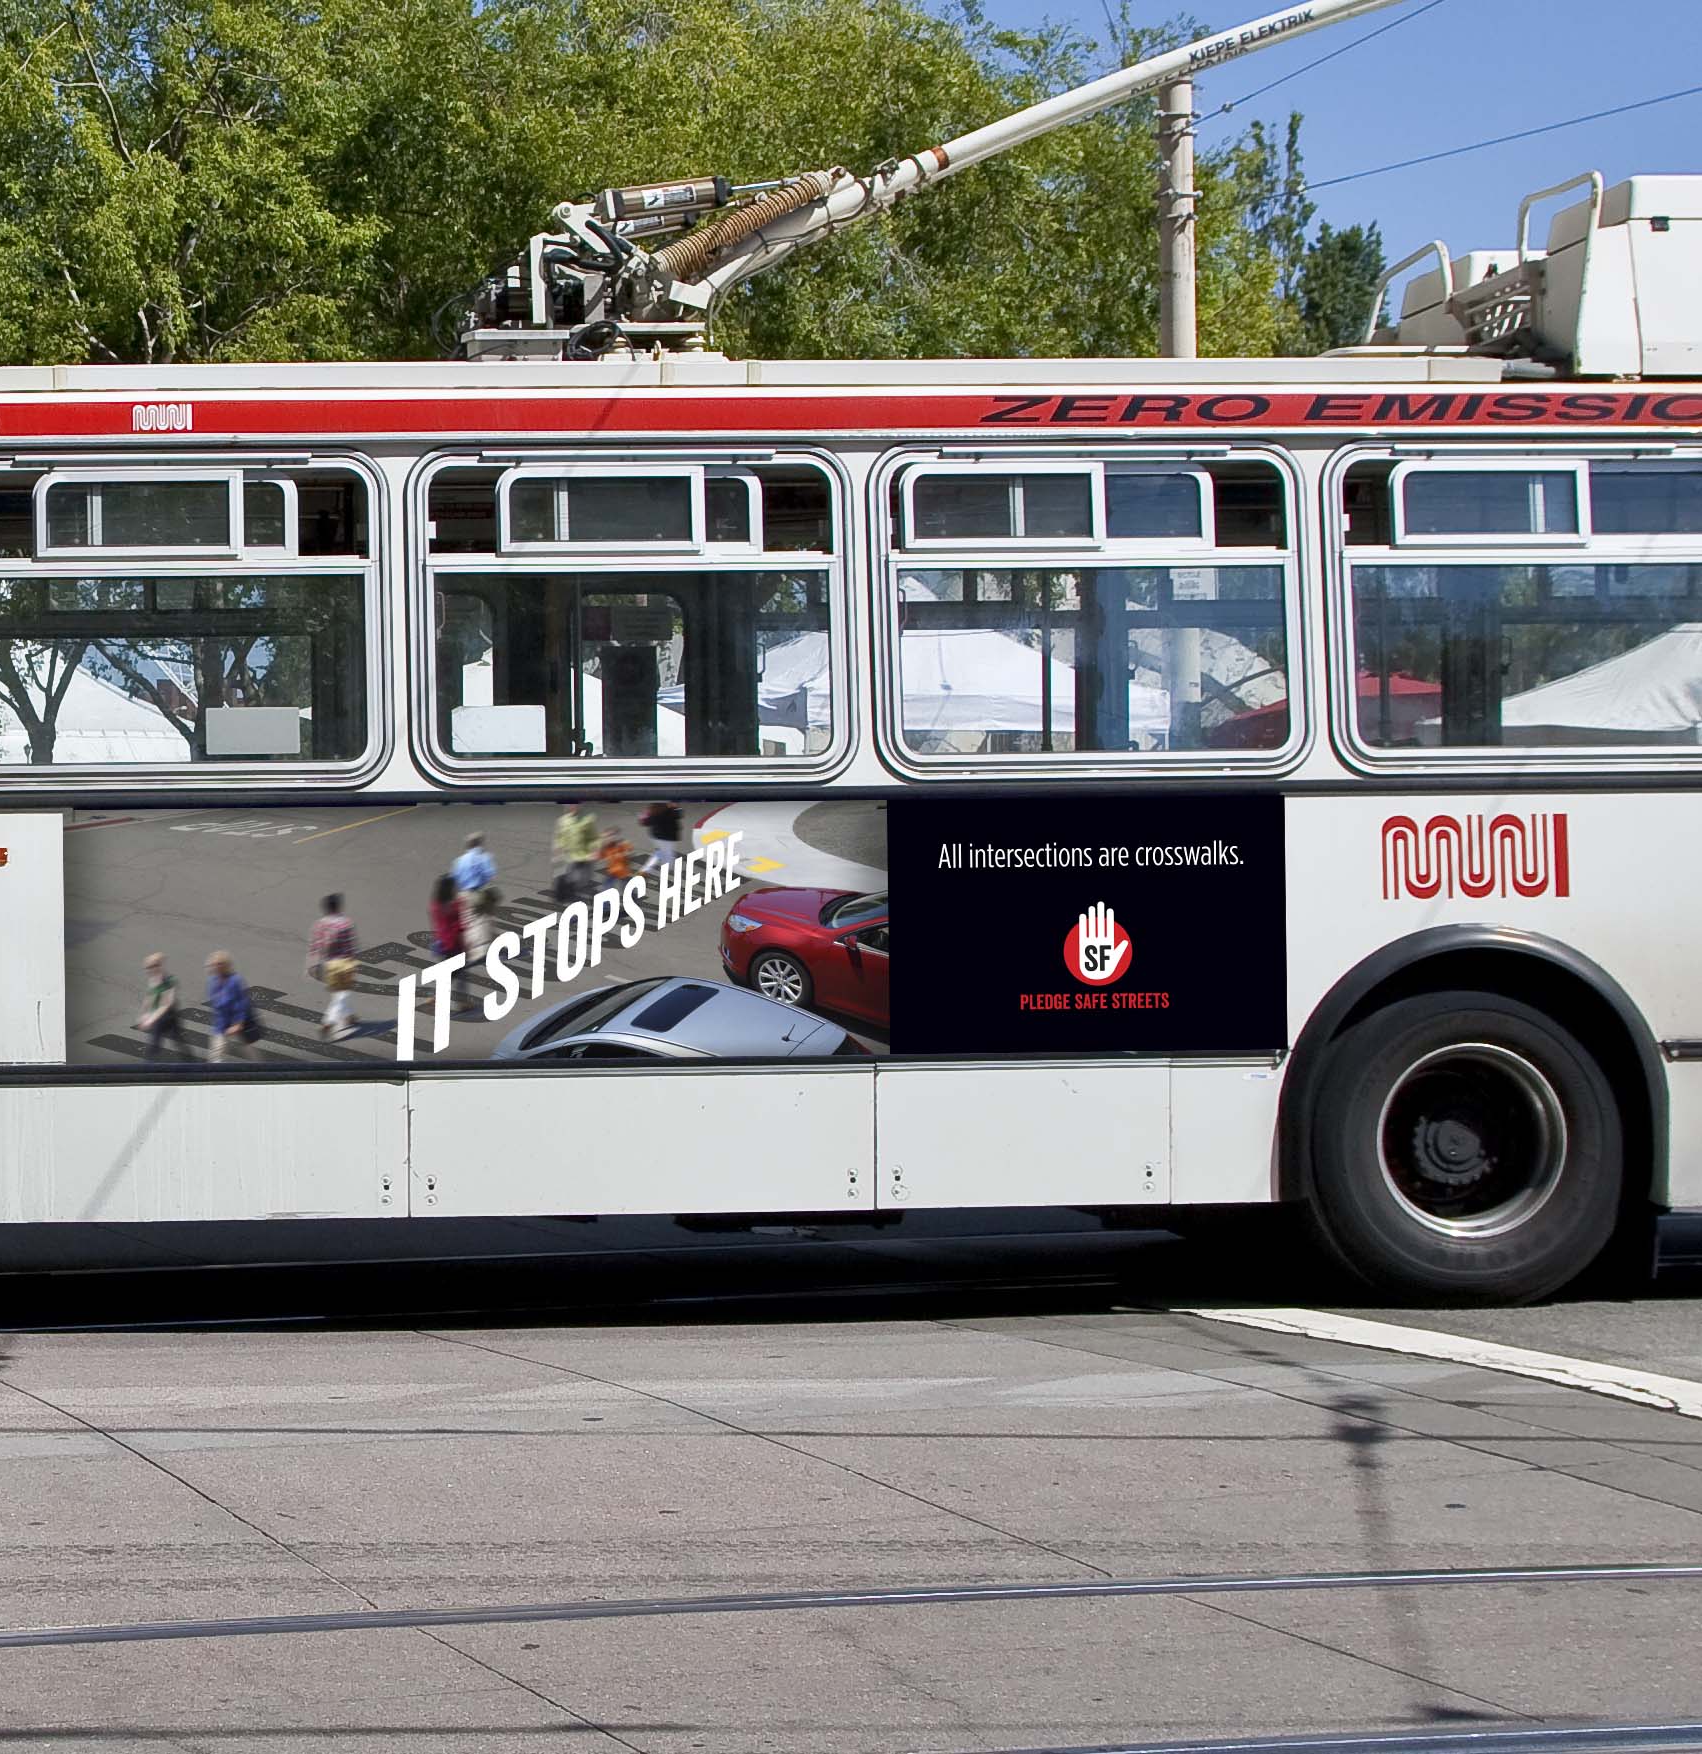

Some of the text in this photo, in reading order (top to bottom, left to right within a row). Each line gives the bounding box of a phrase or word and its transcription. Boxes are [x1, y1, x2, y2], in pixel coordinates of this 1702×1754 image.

[1189, 9, 1315, 65] KIEPE ELEKTRIK
[980, 394, 1275, 423] ZERO
[938, 840, 1245, 869] All intersections are crosswalks.
[396, 951, 466, 1061] IT
[483, 875, 647, 1021] STOPS
[657, 830, 743, 931] HERE
[1084, 944, 1112, 972] SF
[1020, 993, 1170, 1010] PLEDGE SAFE STREETS
